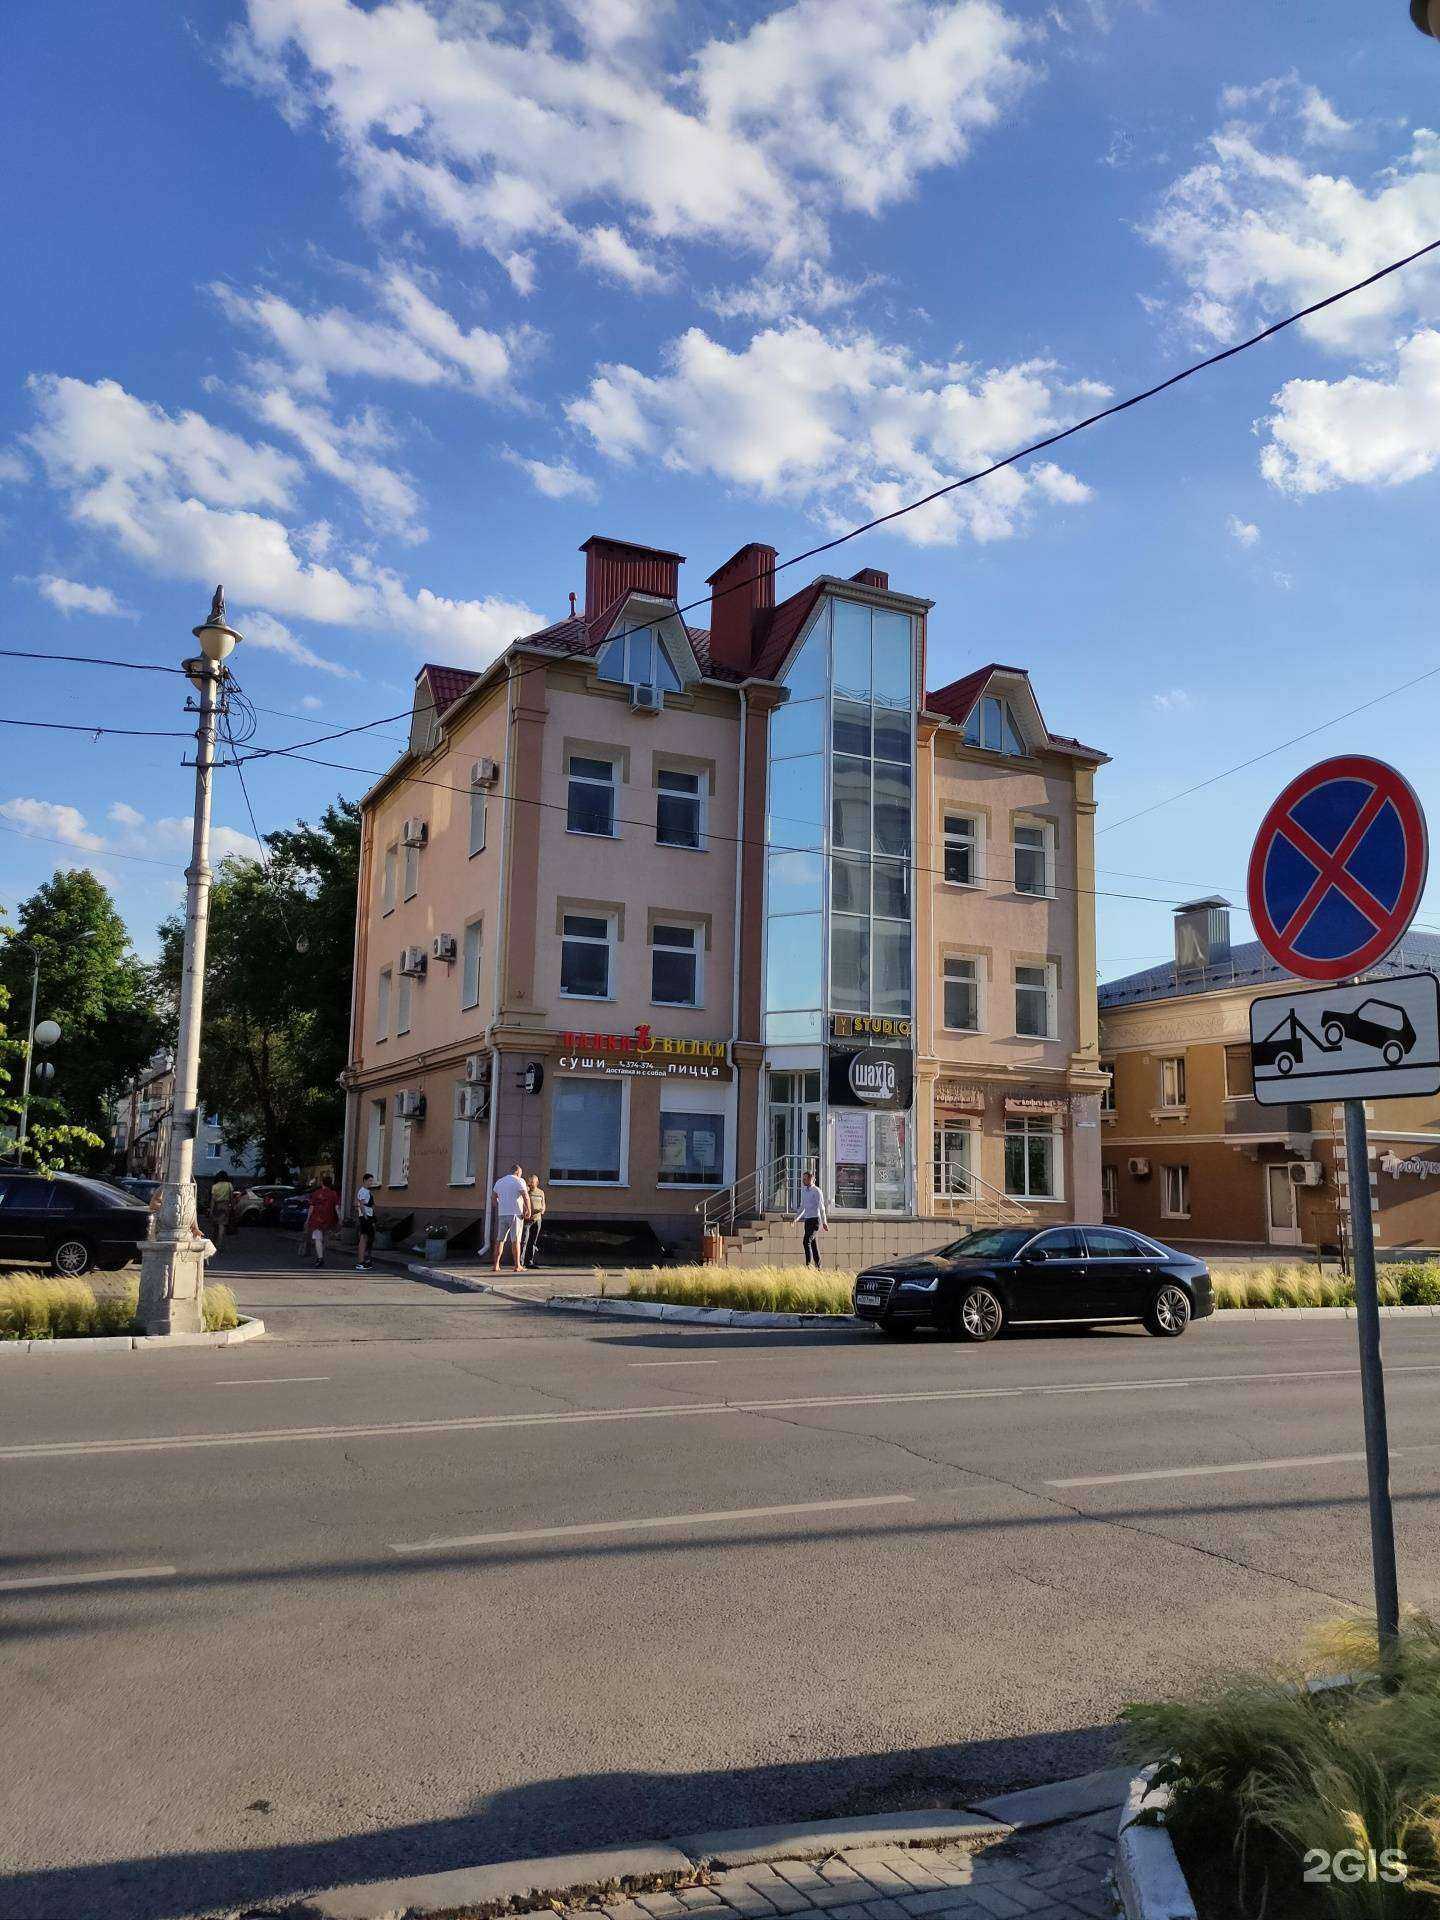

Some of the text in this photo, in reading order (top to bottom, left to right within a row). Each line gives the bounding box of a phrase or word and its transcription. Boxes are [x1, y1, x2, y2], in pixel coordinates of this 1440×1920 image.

[854, 1018, 911, 1035] STUDIO
[563, 1031, 725, 1057] ПАЛКИ ВИЛКИ
[559, 1056, 605, 1070] суши
[668, 1063, 720, 1077] пицца
